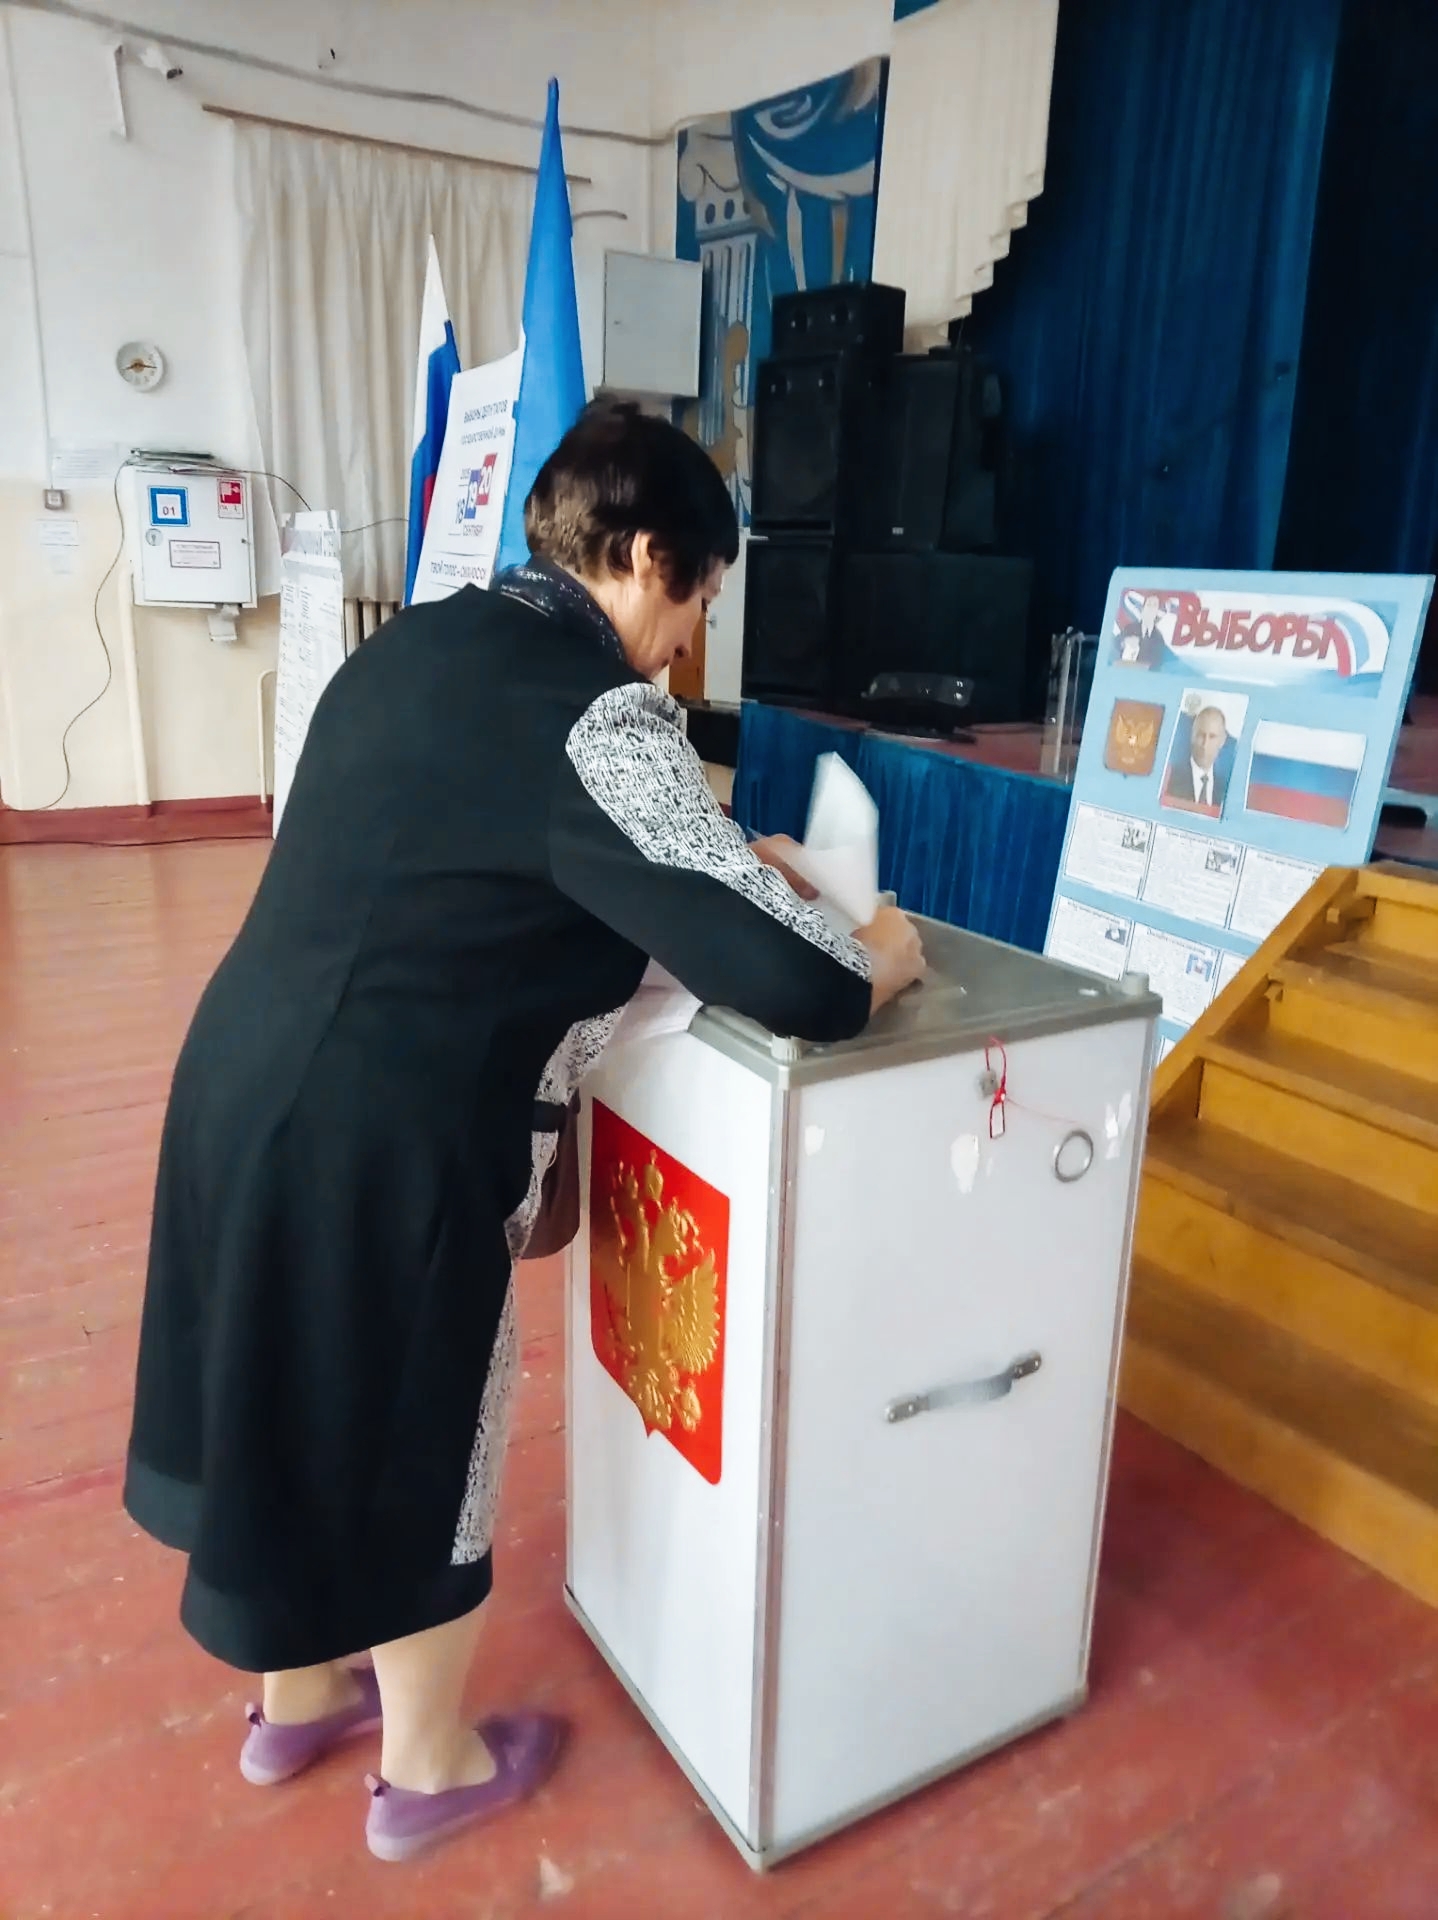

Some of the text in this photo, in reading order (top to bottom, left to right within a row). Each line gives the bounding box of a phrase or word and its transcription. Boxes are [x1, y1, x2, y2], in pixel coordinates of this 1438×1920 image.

[479, 465, 493, 495] 20
[162, 506, 176, 516] 01
[1171, 597, 1337, 660] ВЫБОРЫ
